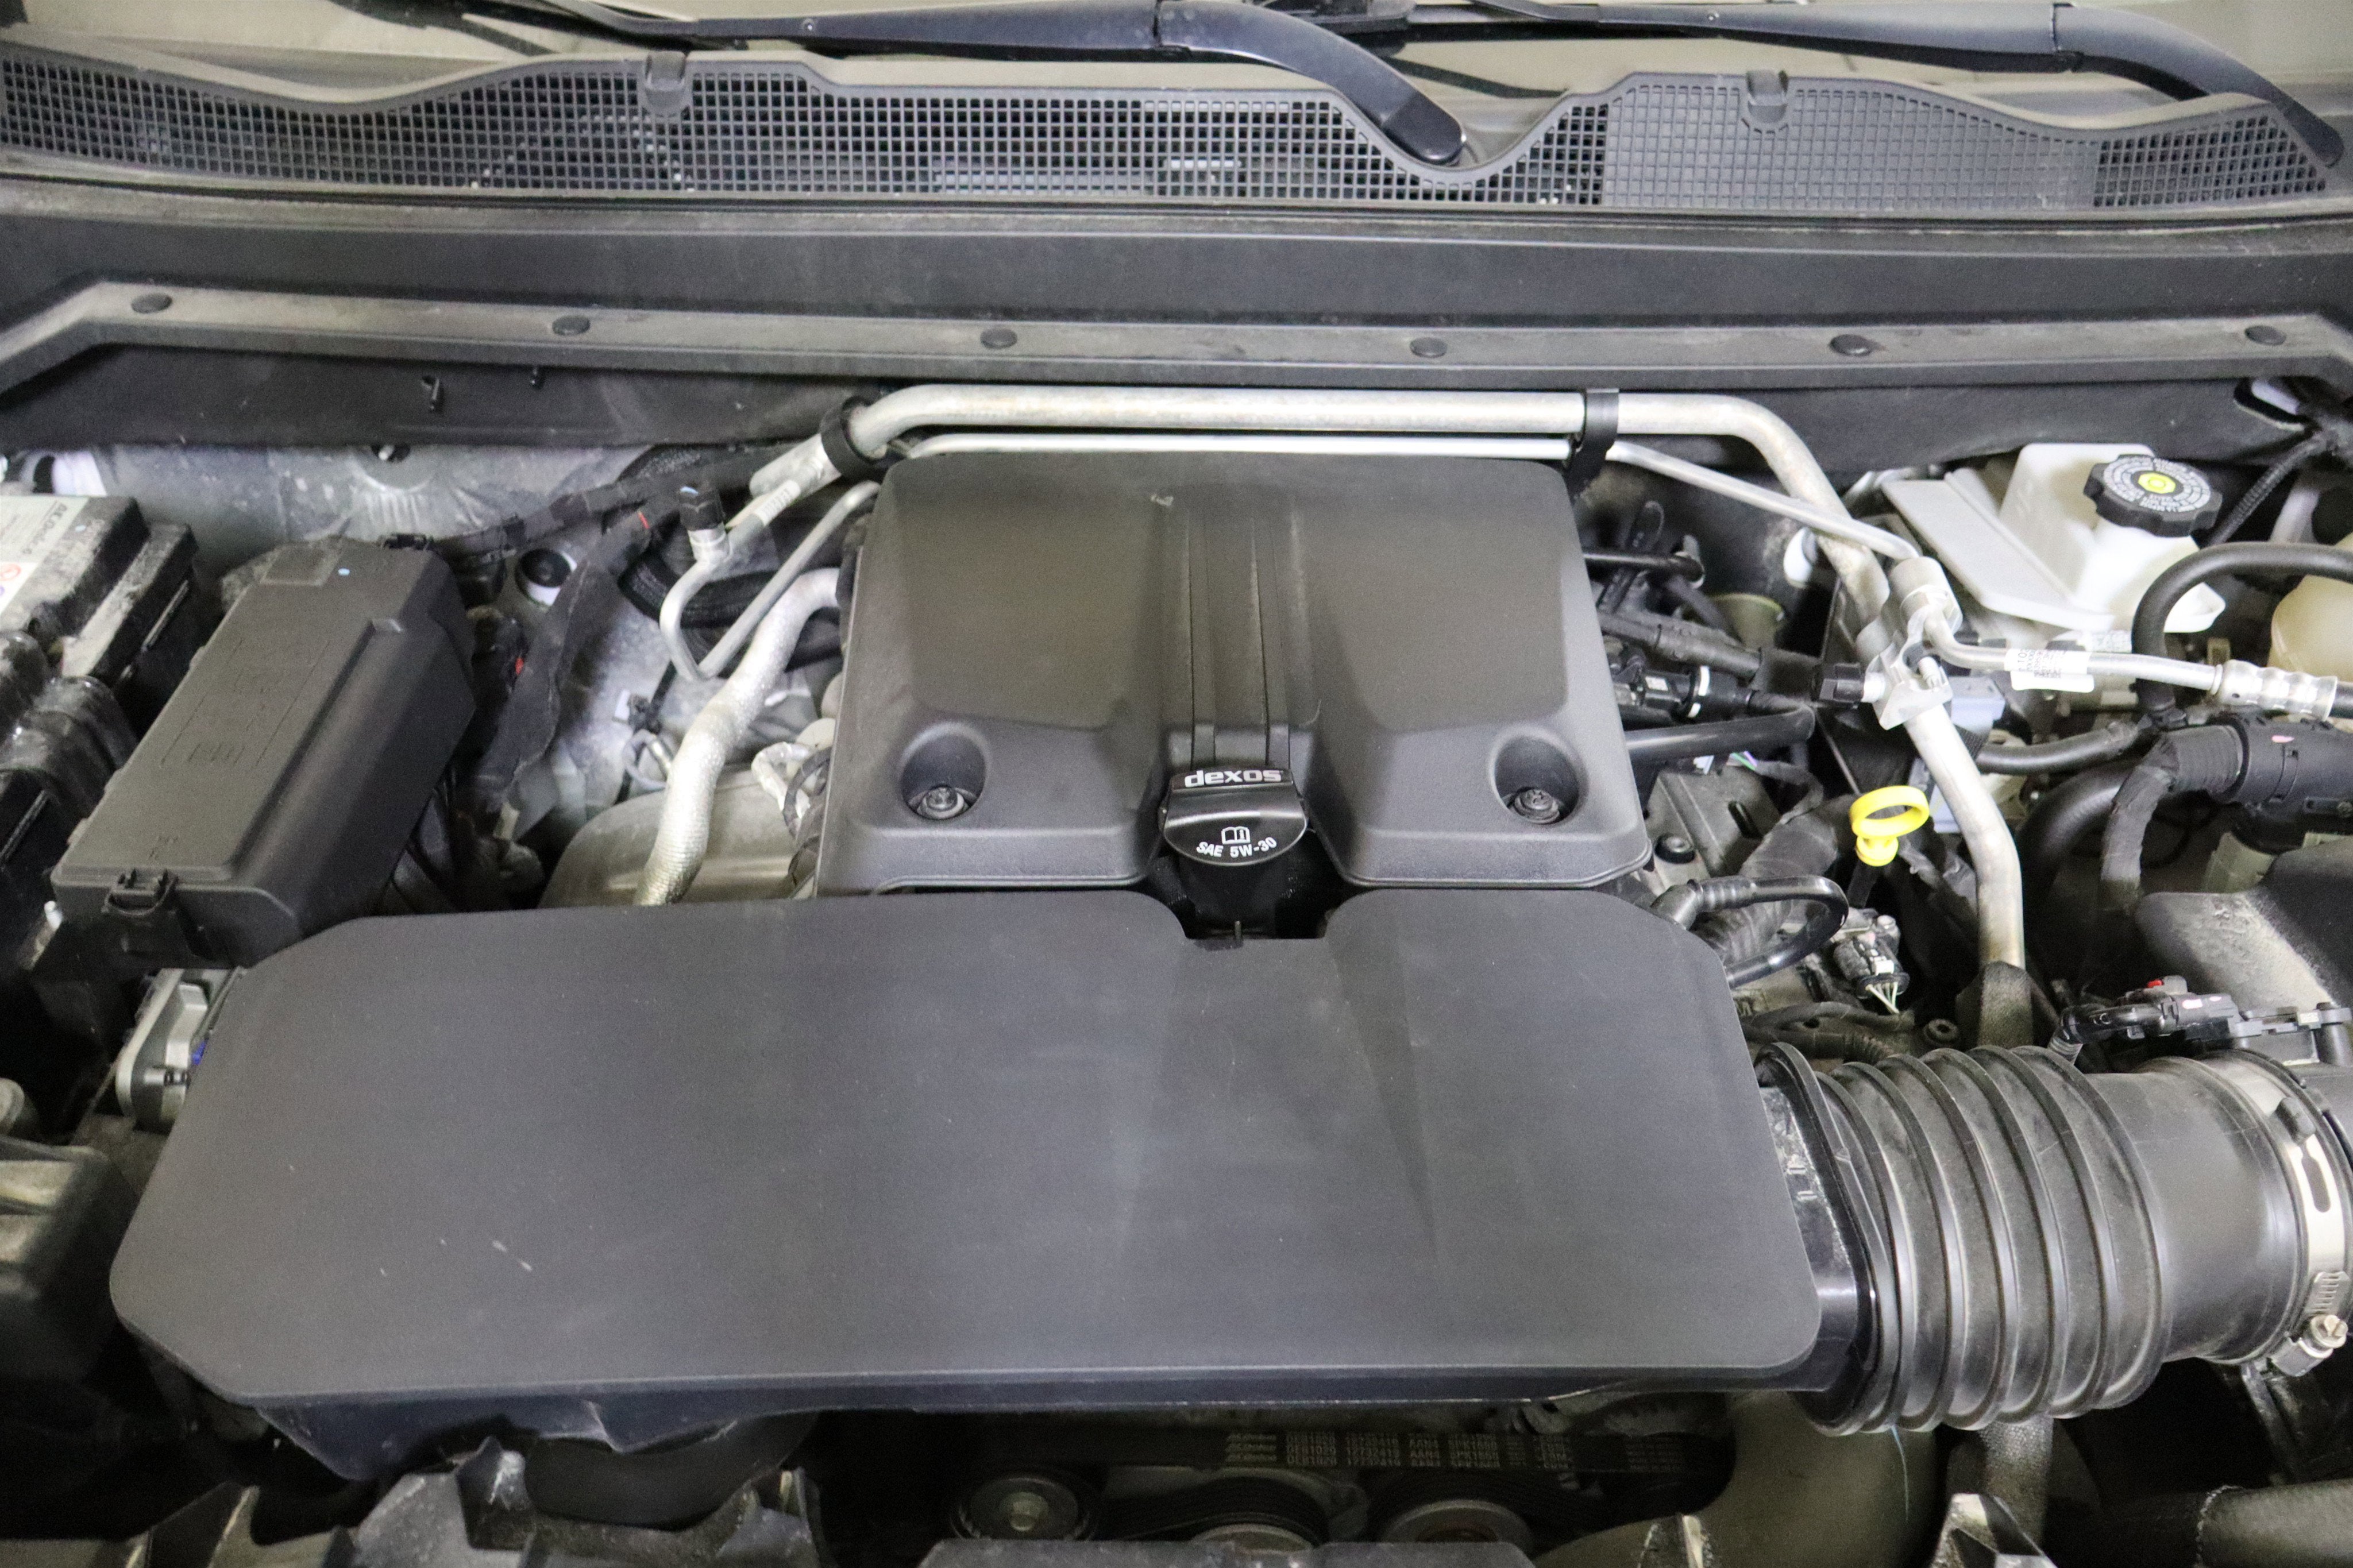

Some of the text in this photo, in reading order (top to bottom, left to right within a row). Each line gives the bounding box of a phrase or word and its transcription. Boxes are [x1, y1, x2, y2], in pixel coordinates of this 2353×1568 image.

[1185, 770, 1282, 787] dexos
[1196, 837, 1277, 858] SAE 5W-30
